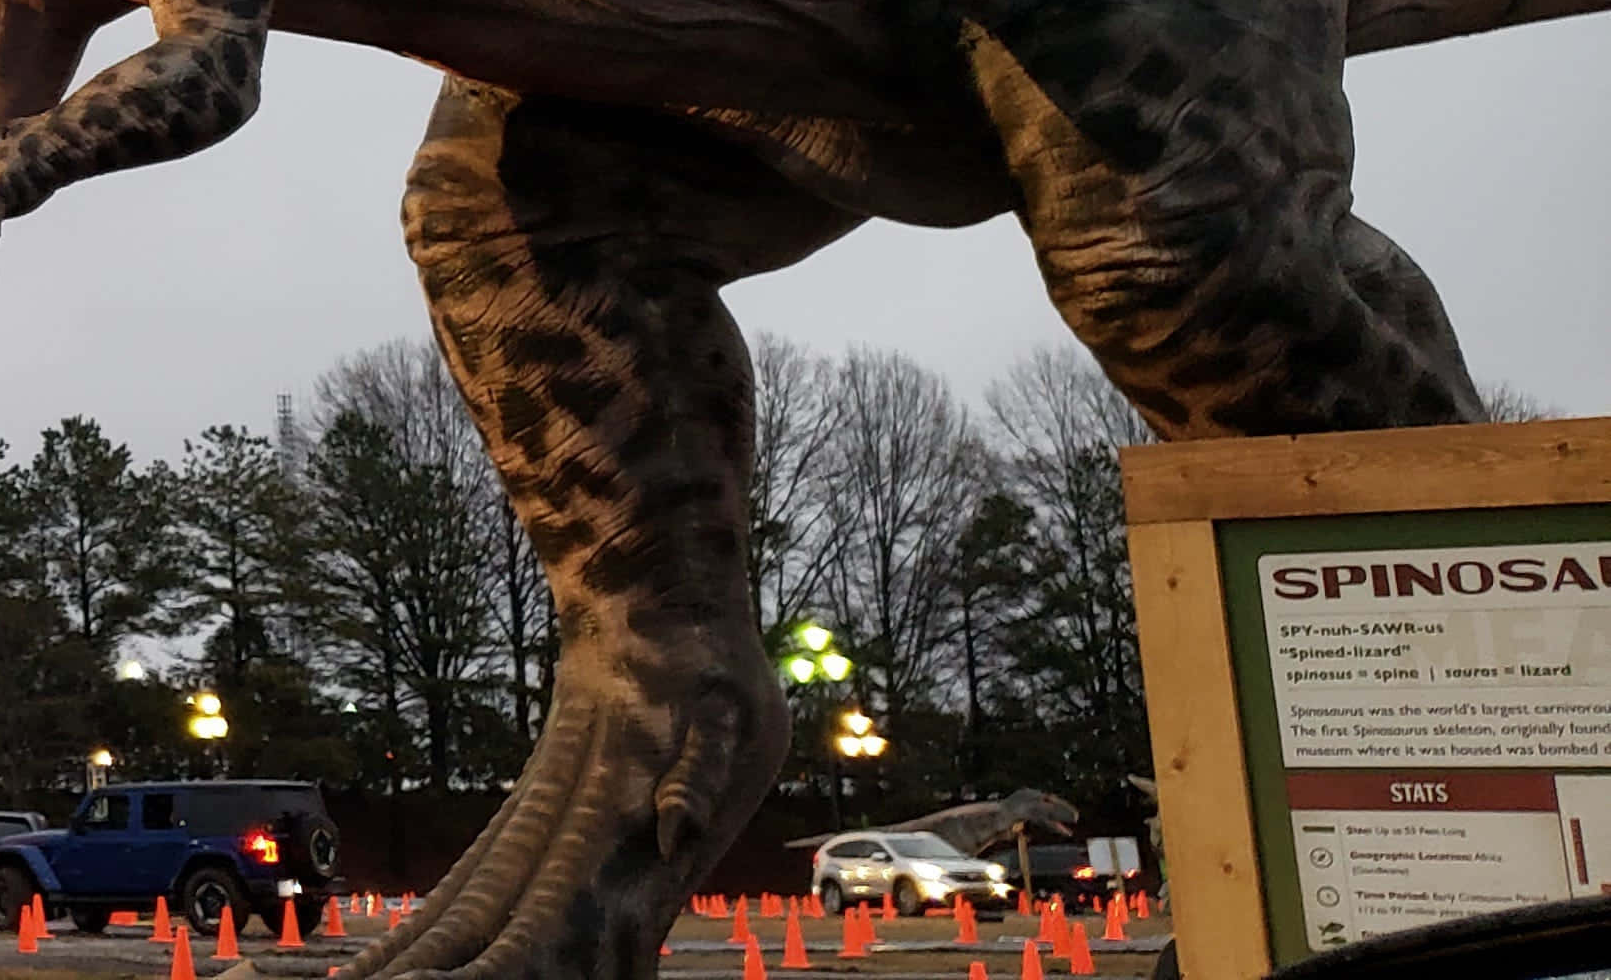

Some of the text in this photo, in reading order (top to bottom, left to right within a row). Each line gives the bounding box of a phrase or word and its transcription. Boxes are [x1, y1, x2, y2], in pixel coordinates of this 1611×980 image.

[1280, 622, 1444, 638] SPY-nuh-SAWR-us
[1374, 667, 1419, 683] spine
[1520, 663, 1572, 677] lizard
[1290, 704, 1364, 719] Spinosaurus
[1368, 706, 1395, 717] was
[1399, 704, 1422, 717] the
[1481, 703, 1530, 718] largest
[1290, 724, 1317, 737] The
[1320, 723, 1349, 737] first
[1353, 724, 1428, 739] Spinosaurus
[1433, 723, 1496, 737] skeleton,
[1500, 722, 1565, 738] originally
[1296, 747, 1353, 757] museum
[1357, 744, 1400, 757] where
[1404, 744, 1416, 757] it
[1419, 747, 1446, 757] was
[1451, 743, 1502, 756] housed
[1506, 746, 1534, 756] was
[1539, 742, 1598, 756] bombed
[1390, 781, 1450, 803] STATS
